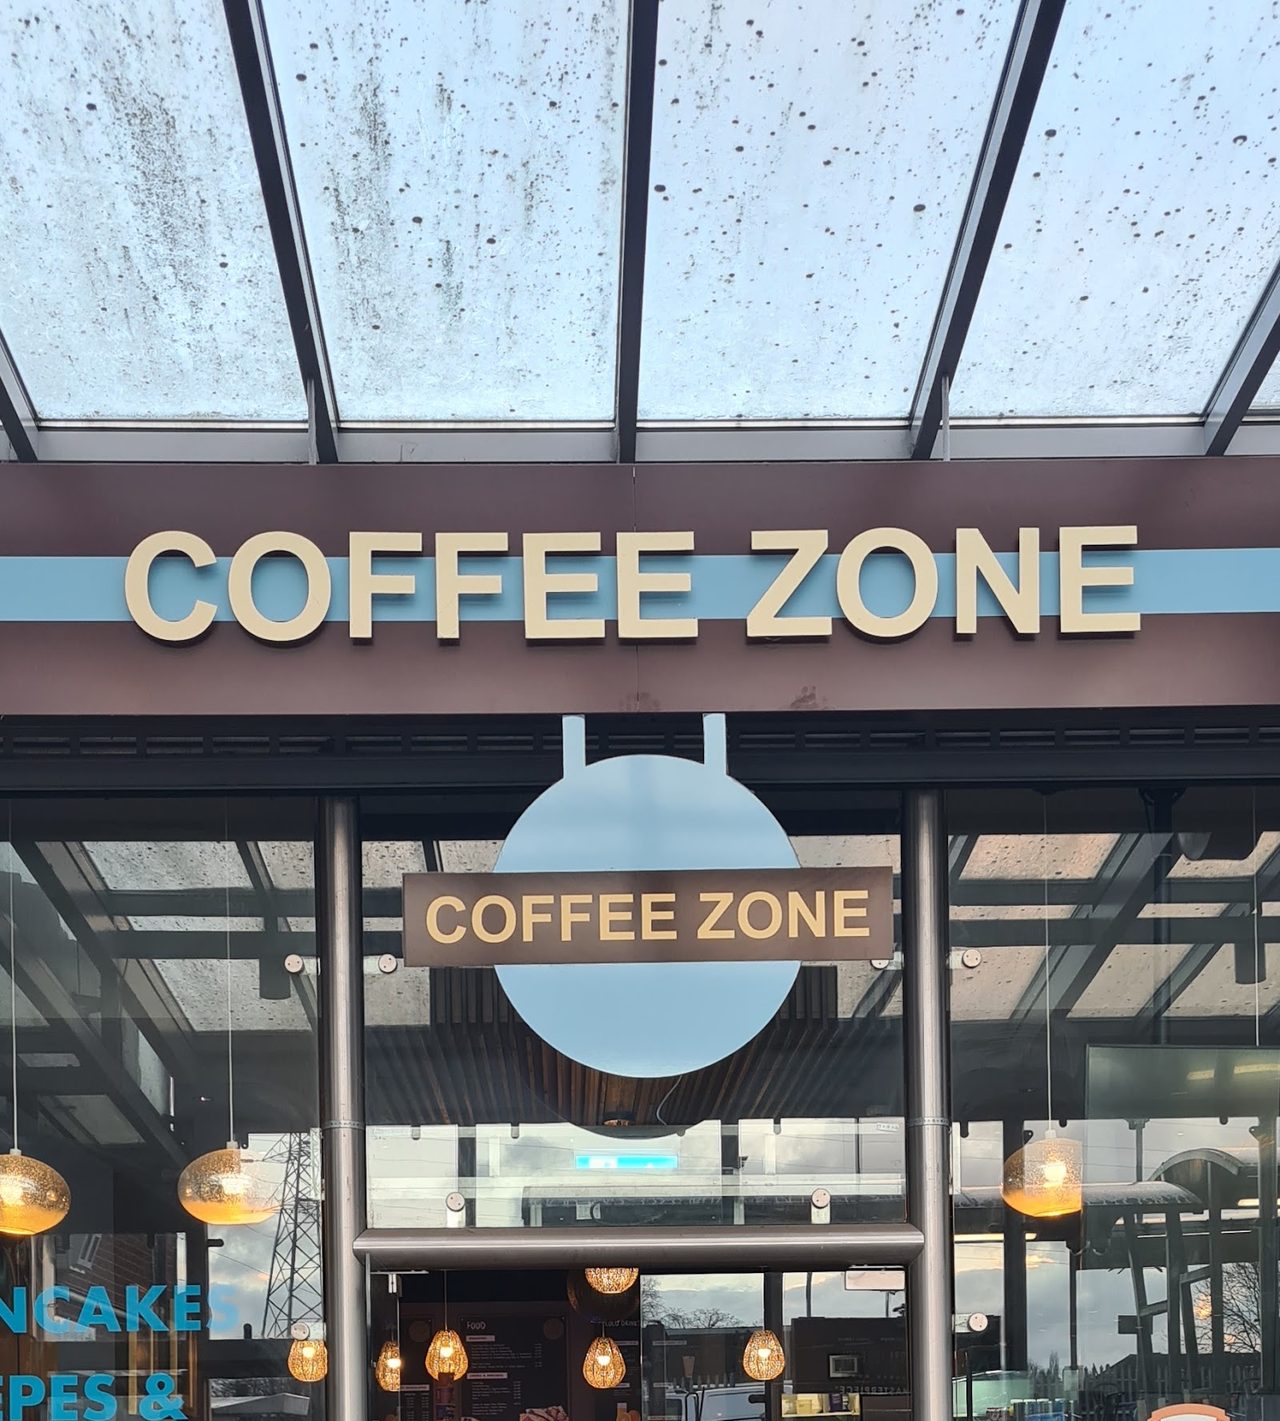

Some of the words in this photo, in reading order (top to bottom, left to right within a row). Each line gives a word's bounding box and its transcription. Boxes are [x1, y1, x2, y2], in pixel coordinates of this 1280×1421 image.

[124, 530, 699, 642] COFFEE
[746, 525, 1142, 638] ZONE
[425, 892, 678, 945] COFFEE
[696, 889, 871, 940] ZONE
[466, 1321, 486, 1330] FOOD
[0, 1374, 118, 1421] PES
[139, 1372, 188, 1421] &
